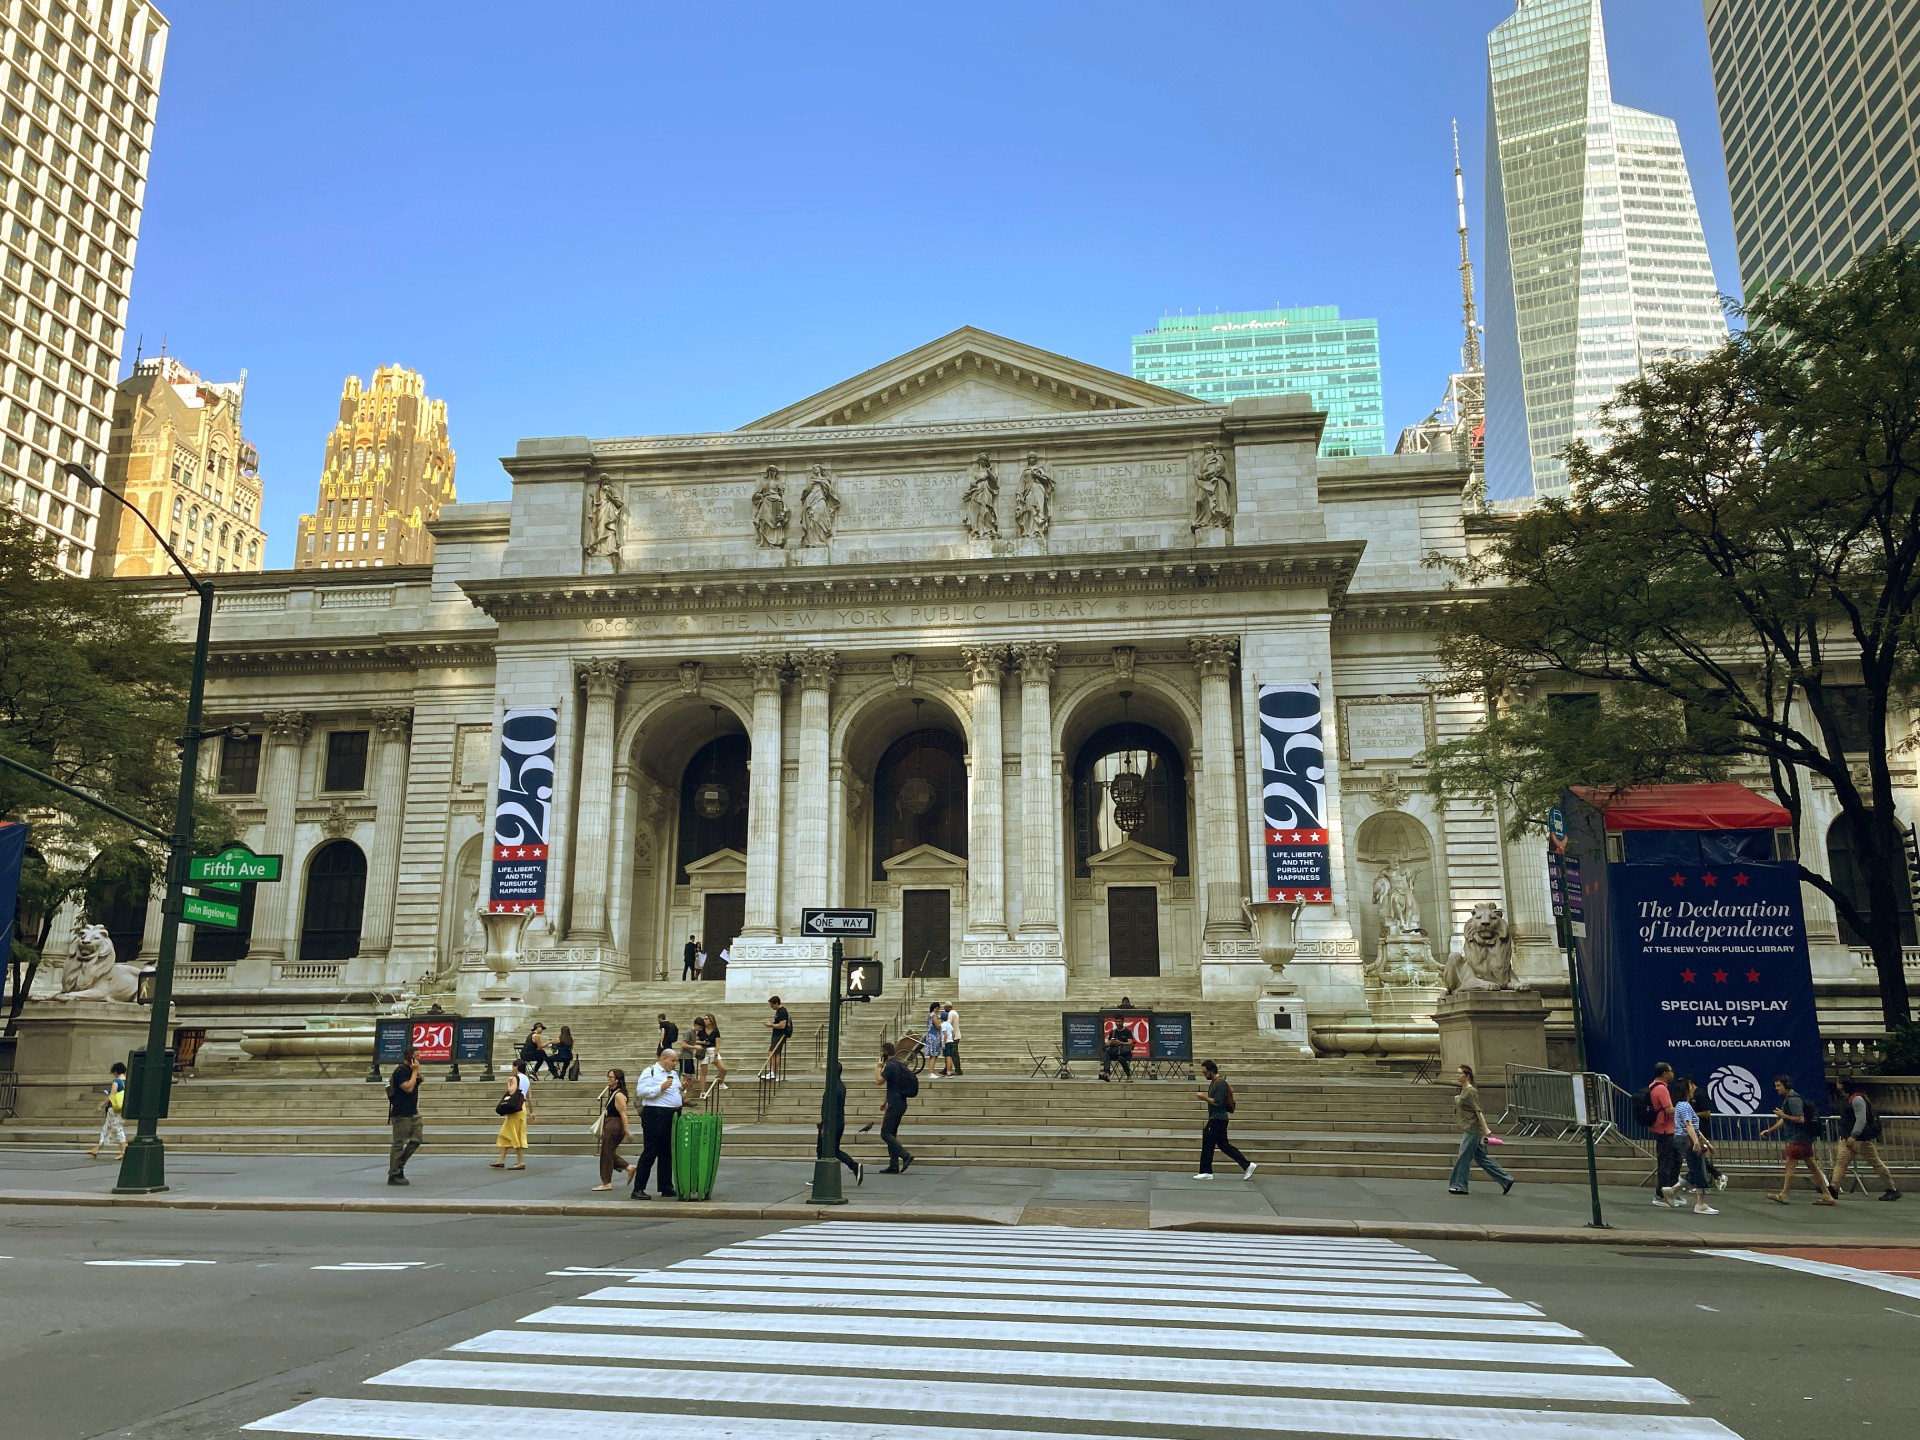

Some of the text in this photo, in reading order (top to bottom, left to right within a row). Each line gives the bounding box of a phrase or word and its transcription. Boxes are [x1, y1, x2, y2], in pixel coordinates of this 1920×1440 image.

[1058, 463, 1180, 480] THE TILDEN TRUST
[844, 475, 960, 490] THE LENOX LIBRARY
[637, 486, 749, 500] THE ASTOR LIBRARY
[1107, 487, 1135, 495] JONES
[1139, 485, 1169, 493] TILDEN
[869, 497, 935, 507] JAMES LENOX
[676, 508, 702, 516] JACOB
[705, 614, 749, 630] THE
[766, 612, 818, 627] NEW
[837, 609, 892, 625] YORK
[910, 605, 986, 622] PUBLIC
[1007, 600, 1099, 619] LIBRARY
[1372, 718, 1399, 726] TRUTH
[1356, 729, 1392, 737] BEARETH
[1259, 683, 1327, 829] 250
[494, 708, 558, 846] 250
[203, 862, 266, 876] Fifth Ave
[188, 904, 202, 914] John
[202, 906, 226, 919] Bigelow
[1637, 900, 1790, 918] The Declaration
[815, 919, 863, 928] ONE WAY
[1639, 919, 1794, 943] of Independence
[1722, 945, 1755, 953] PUBLIC
[1756, 945, 1795, 953] LIBRARY
[1661, 1000, 1788, 1011] SPECIAL DISPLAY
[1695, 1015, 1728, 1026] JULY
[412, 1025, 454, 1048] 250
[1668, 1039, 1791, 1048] NYPL.ORG/DECLARATION
